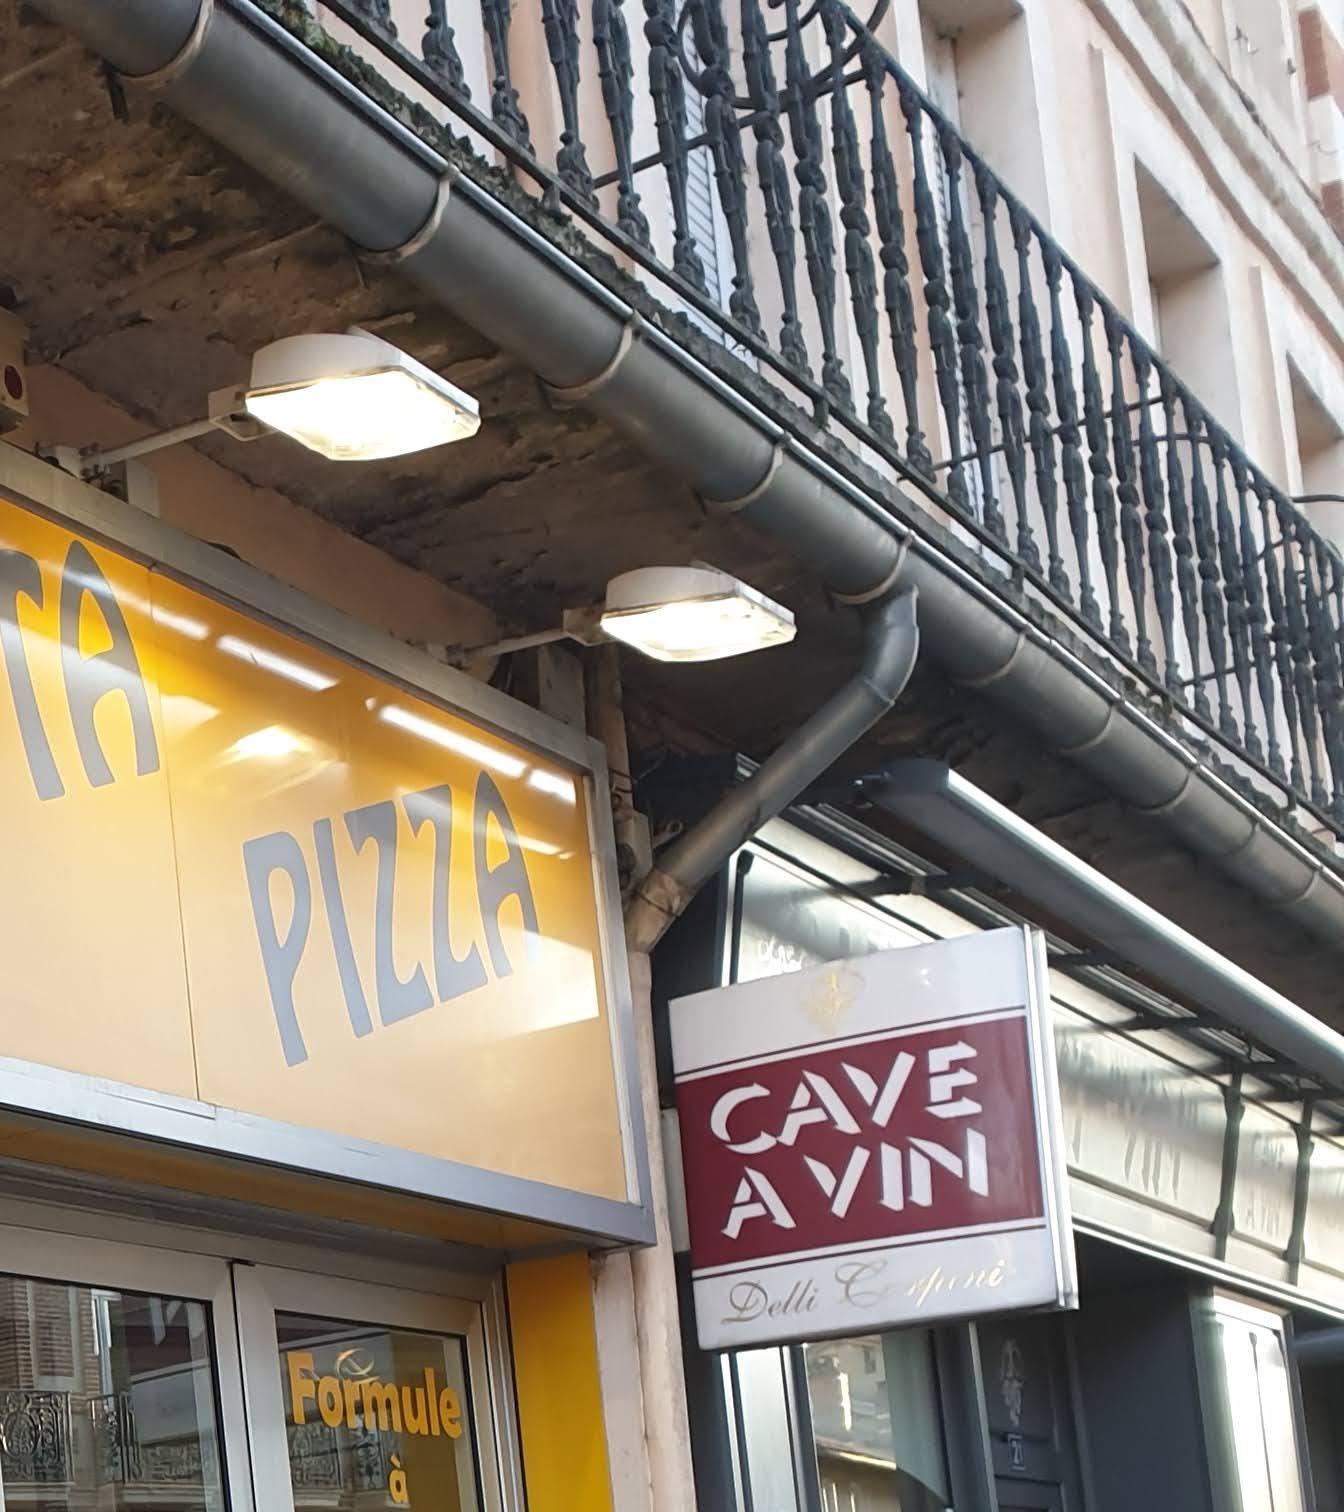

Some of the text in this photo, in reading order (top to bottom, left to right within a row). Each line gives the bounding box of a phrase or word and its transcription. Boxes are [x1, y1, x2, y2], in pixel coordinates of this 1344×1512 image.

[242, 768, 541, 1068] PIZZA
[711, 1040, 983, 1155] CAVE
[720, 1128, 989, 1240] A VIN
[287, 1351, 463, 1439] Formule
[389, 1454, 408, 1504] à
